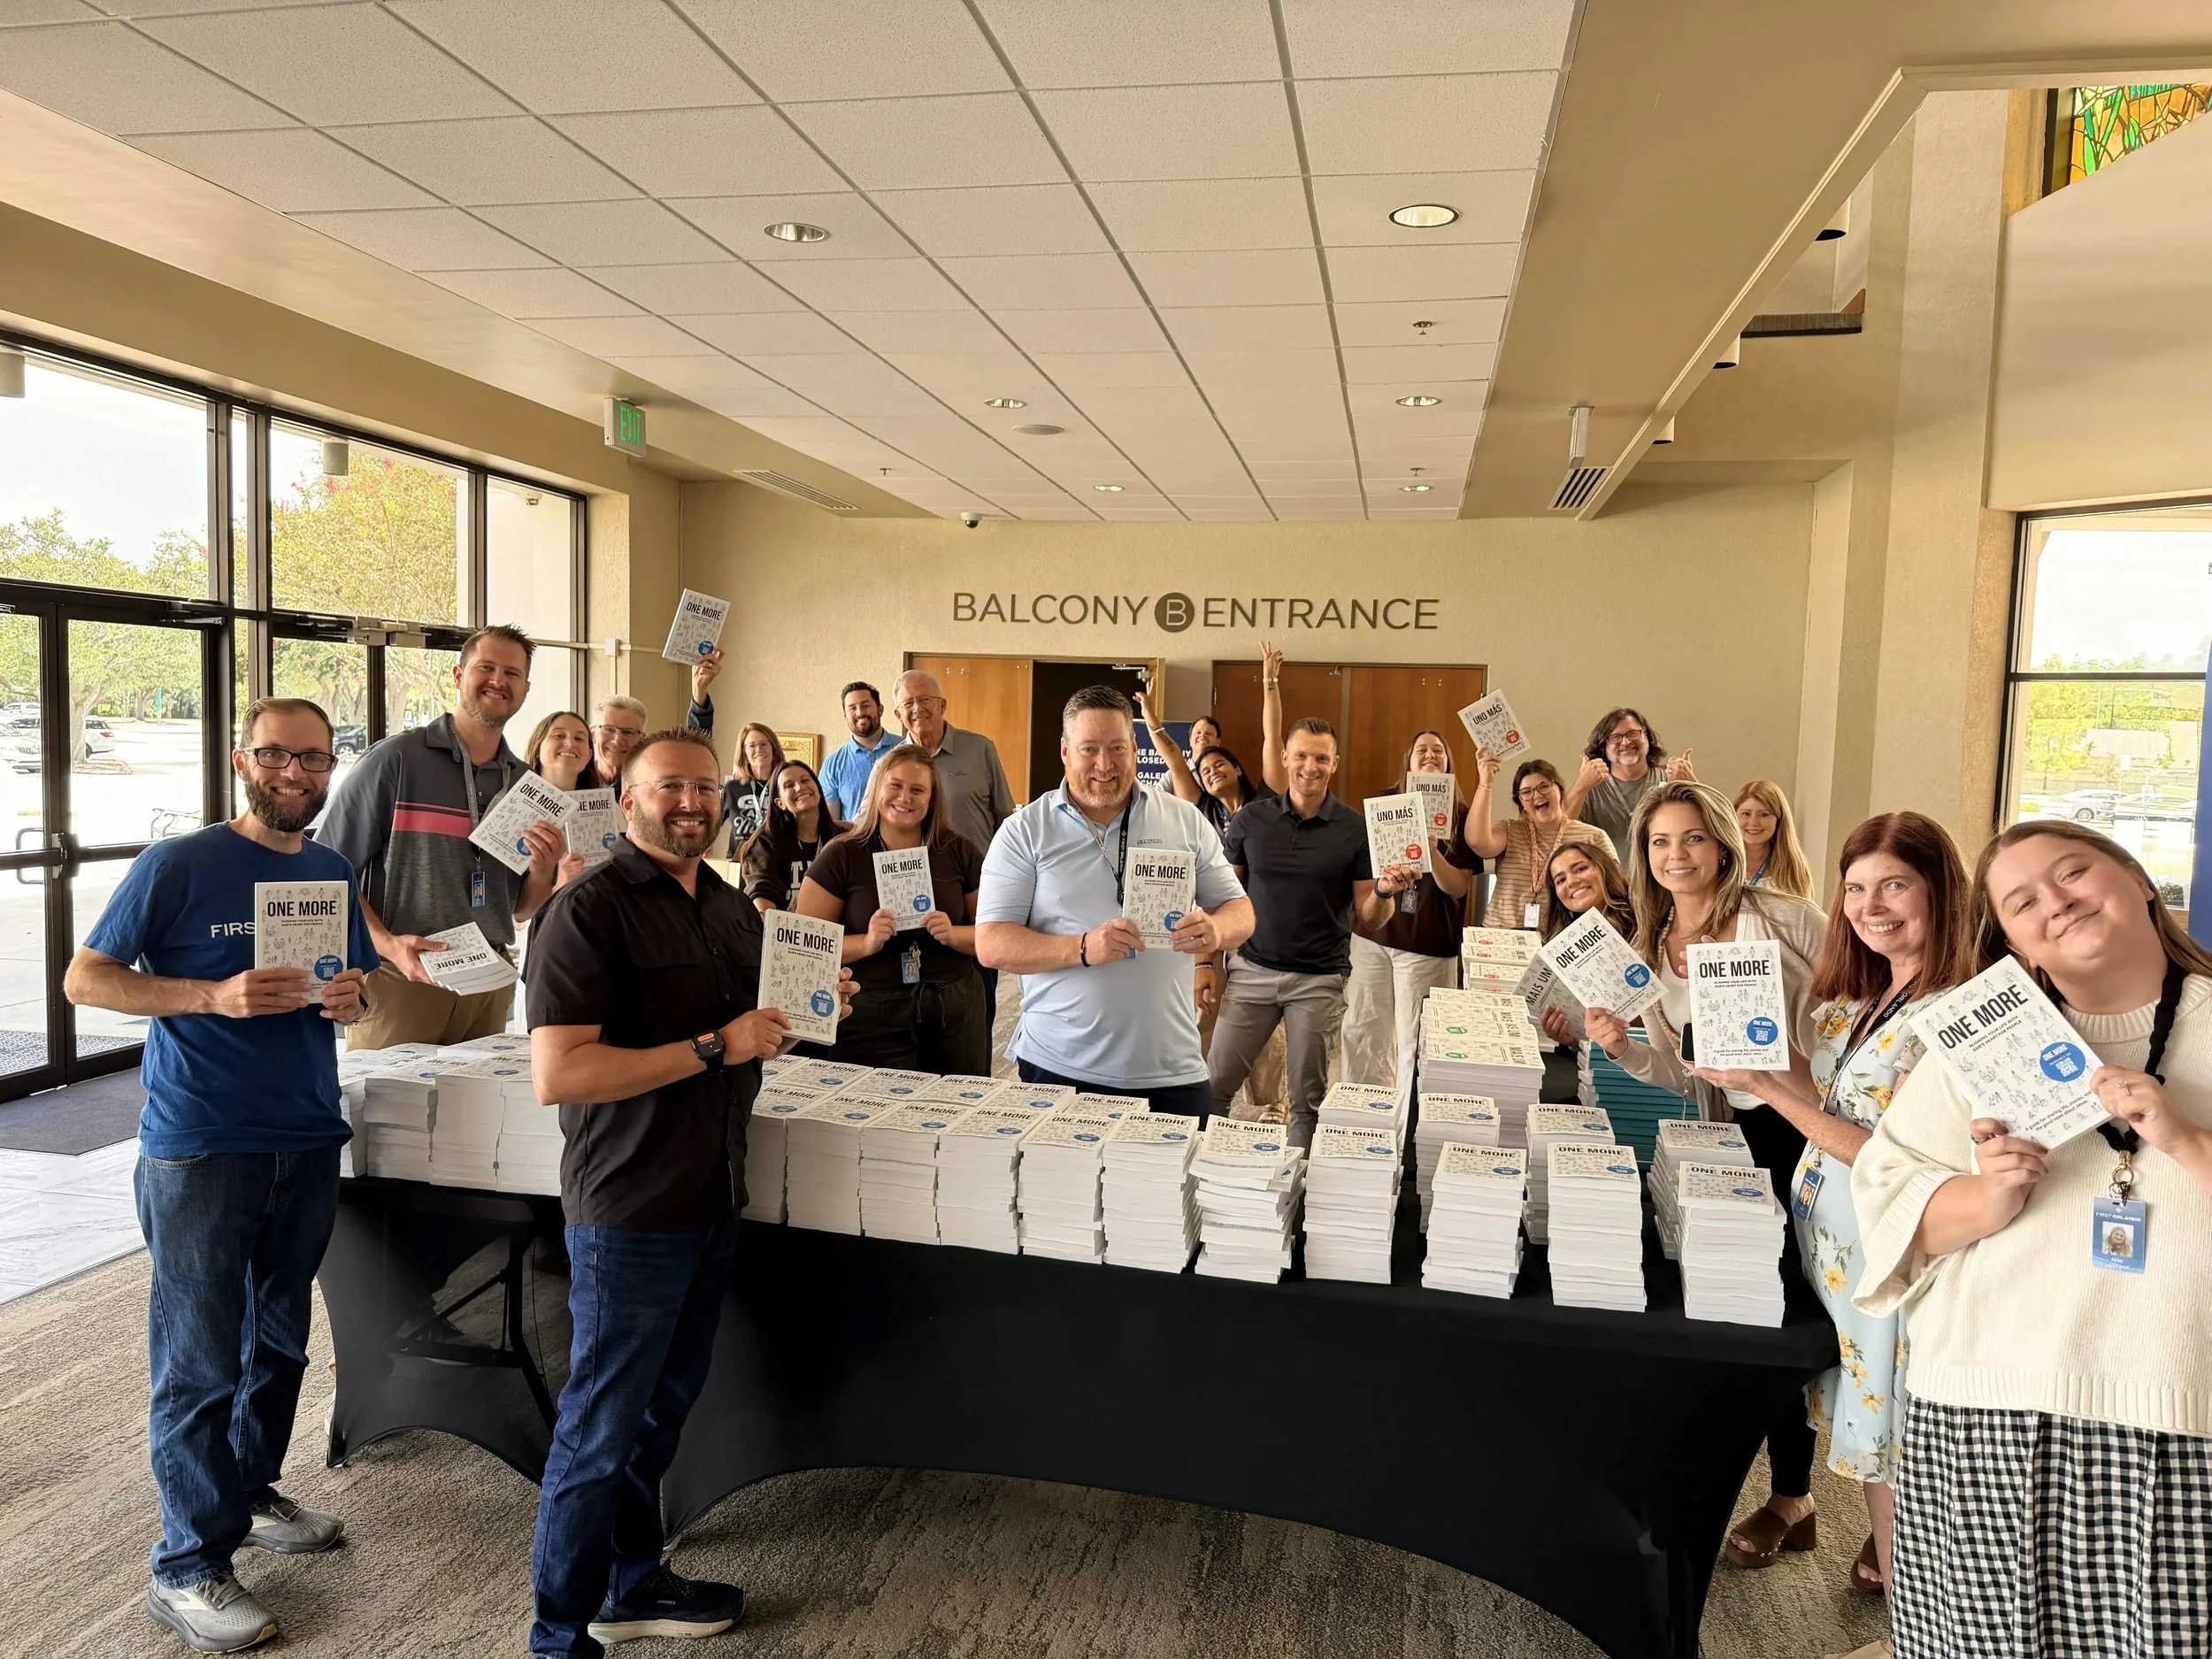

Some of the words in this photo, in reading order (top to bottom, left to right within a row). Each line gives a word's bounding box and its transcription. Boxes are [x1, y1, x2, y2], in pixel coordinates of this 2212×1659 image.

[620, 406, 641, 446] EXIT
[686, 601, 701, 616] ONE
[701, 605, 722, 620] MORE
[953, 592, 1148, 625] BALCONY
[1203, 597, 1440, 629] ENTRANCE
[1472, 712, 1488, 725] UNO
[1486, 704, 1502, 717] MÁS
[1416, 783, 1430, 792] UNO
[1431, 783, 1446, 793] MÁS
[520, 783, 538, 800] ONE
[537, 794, 565, 817] MORE
[589, 800, 611, 810] MORE
[1377, 811, 1393, 822] UNO
[1395, 806, 1413, 819] MÁS
[882, 862, 898, 874] ONE
[900, 859, 923, 872] MORE
[1135, 864, 1155, 878] ONE
[1157, 865, 1186, 879] MORE
[267, 902, 294, 917] ONE
[299, 901, 336, 916] MORE
[210, 922, 255, 938] FIRS
[777, 928, 801, 946] ONE
[803, 932, 835, 954] MORE
[1556, 948, 1580, 968] ONE
[1576, 925, 1607, 954] MORE
[1699, 962, 1727, 978] ONE
[1731, 960, 1770, 977] MORE
[1526, 983, 1541, 1006] MAIS
[1537, 967, 1553, 983] UM
[1883, 992, 1908, 1018] ORLANDO
[1938, 1015, 1979, 1050] ONE
[1972, 984, 2028, 1028] MORE
[2042, 1051, 2054, 1061] ONE
[2052, 1043, 2068, 1056] MORE
[898, 1073, 928, 1081] MORE
[786, 1091, 819, 1099] MORE
[857, 1099, 889, 1108] MORE
[1001, 1112, 1033, 1120] MORE
[1217, 1121, 1240, 1130] ONE
[1243, 1125, 1277, 1134] MORE
[1481, 1149, 1516, 1158] MORE
[1721, 1169, 1760, 1179] MORE
